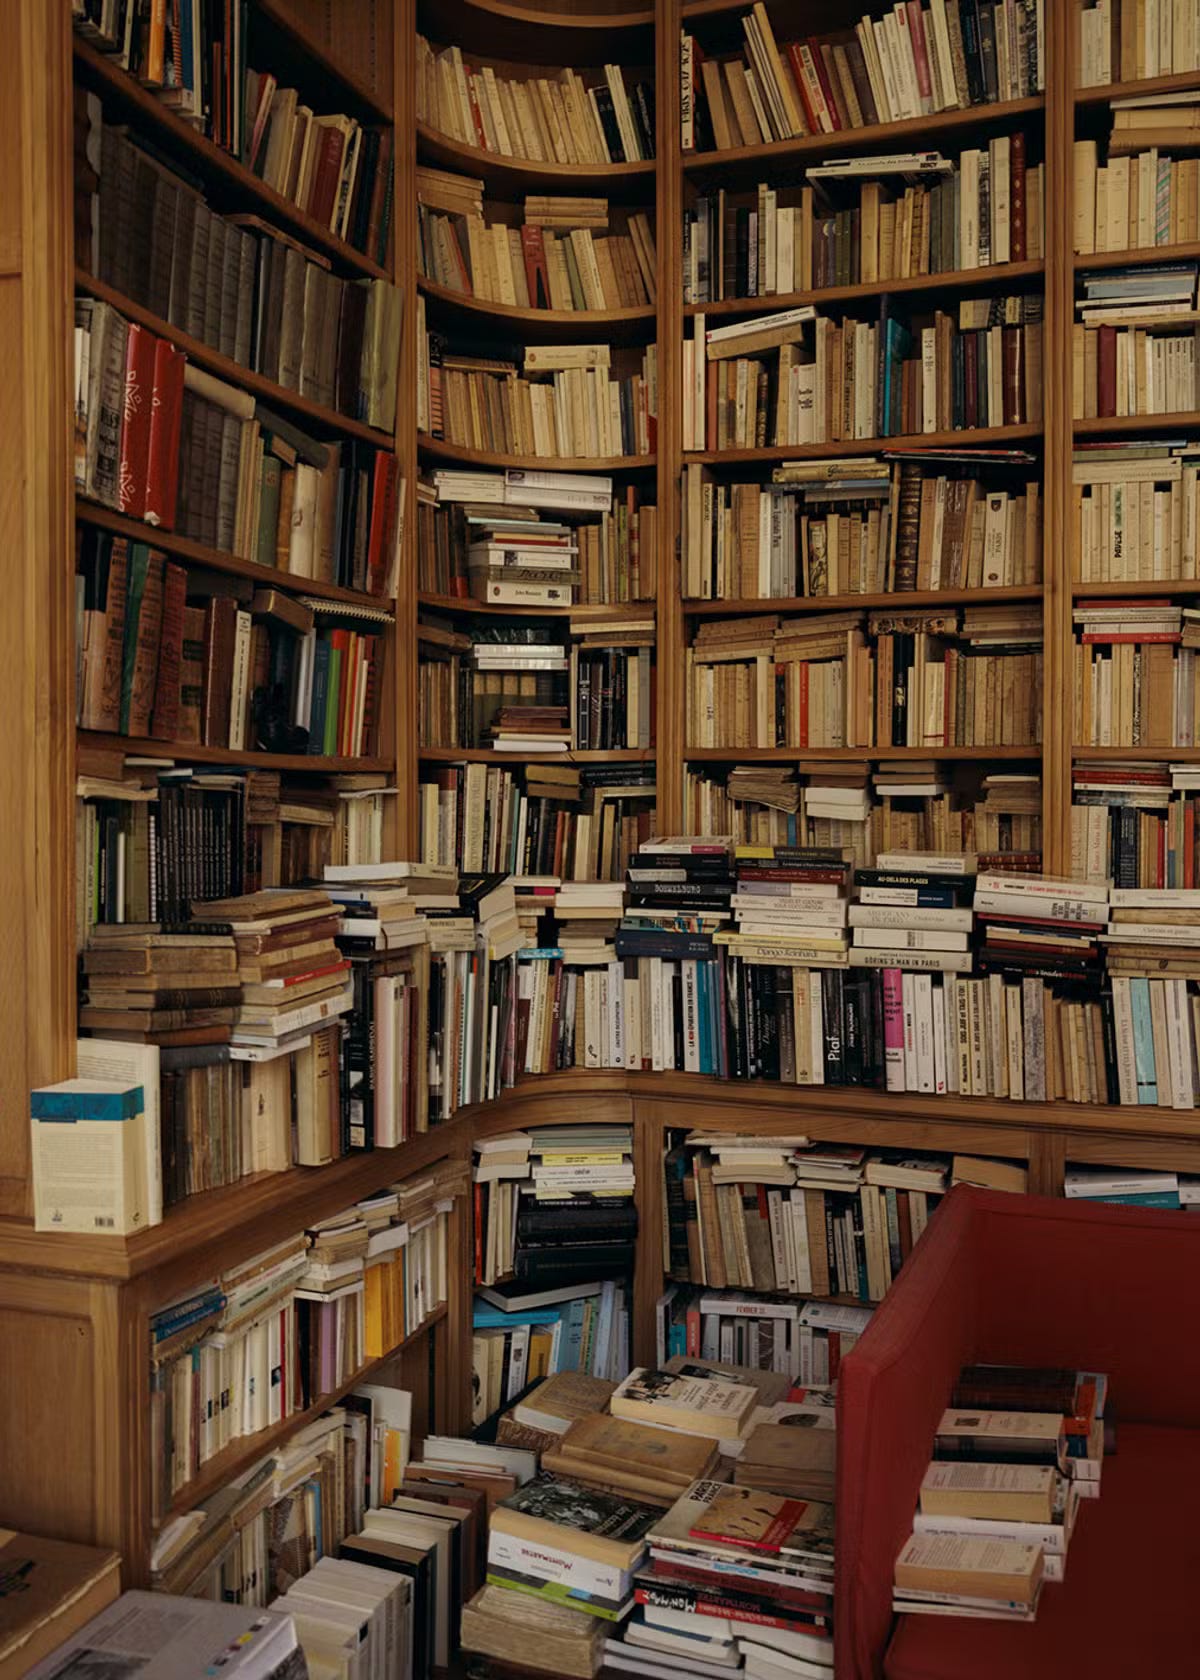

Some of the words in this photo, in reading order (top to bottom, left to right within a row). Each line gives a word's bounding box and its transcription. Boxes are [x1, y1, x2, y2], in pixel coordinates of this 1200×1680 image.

[1114, 530, 1122, 558] PAVESE
[756, 947, 784, 958] Django
[921, 960, 941, 968] PARIS
[960, 1030, 968, 1043] SOIS
[688, 1040, 695, 1048] LA
[826, 1035, 841, 1061] Piaf
[690, 1481, 712, 1502] PARIS
